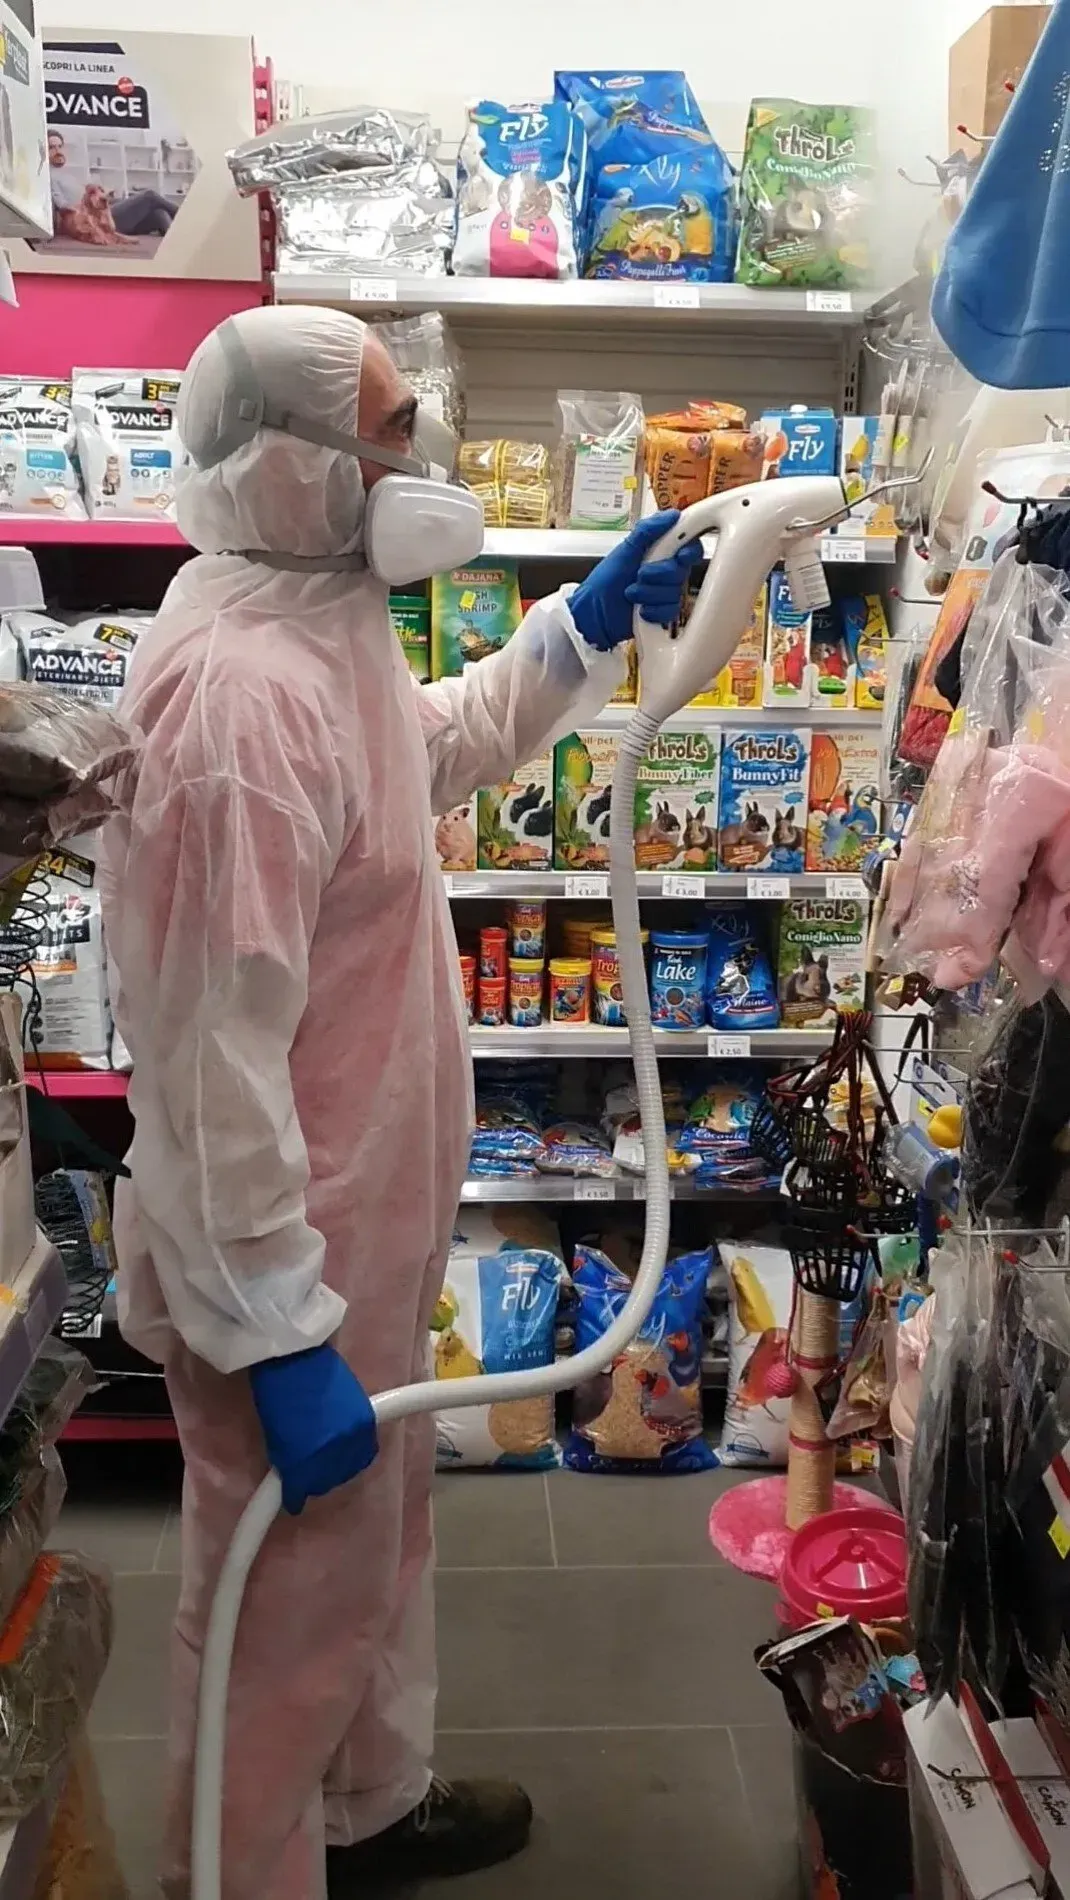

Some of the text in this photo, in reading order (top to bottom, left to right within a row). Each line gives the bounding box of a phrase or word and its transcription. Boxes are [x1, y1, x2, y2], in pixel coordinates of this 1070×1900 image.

[88, 64, 115, 72] LINEA
[44, 92, 143, 117] DVANCE
[499, 116, 549, 141] Fly
[147, 384, 158, 399] 3
[788, 436, 825, 461] Fly
[462, 572, 500, 582] DAJANA
[101, 626, 114, 641] 7
[32, 654, 122, 675] ADVANCE
[37, 671, 90, 681] ETERINARY
[732, 767, 800, 784] BunnyFit
[656, 961, 697, 981] Lake
[501, 1276, 541, 1311] Fly
